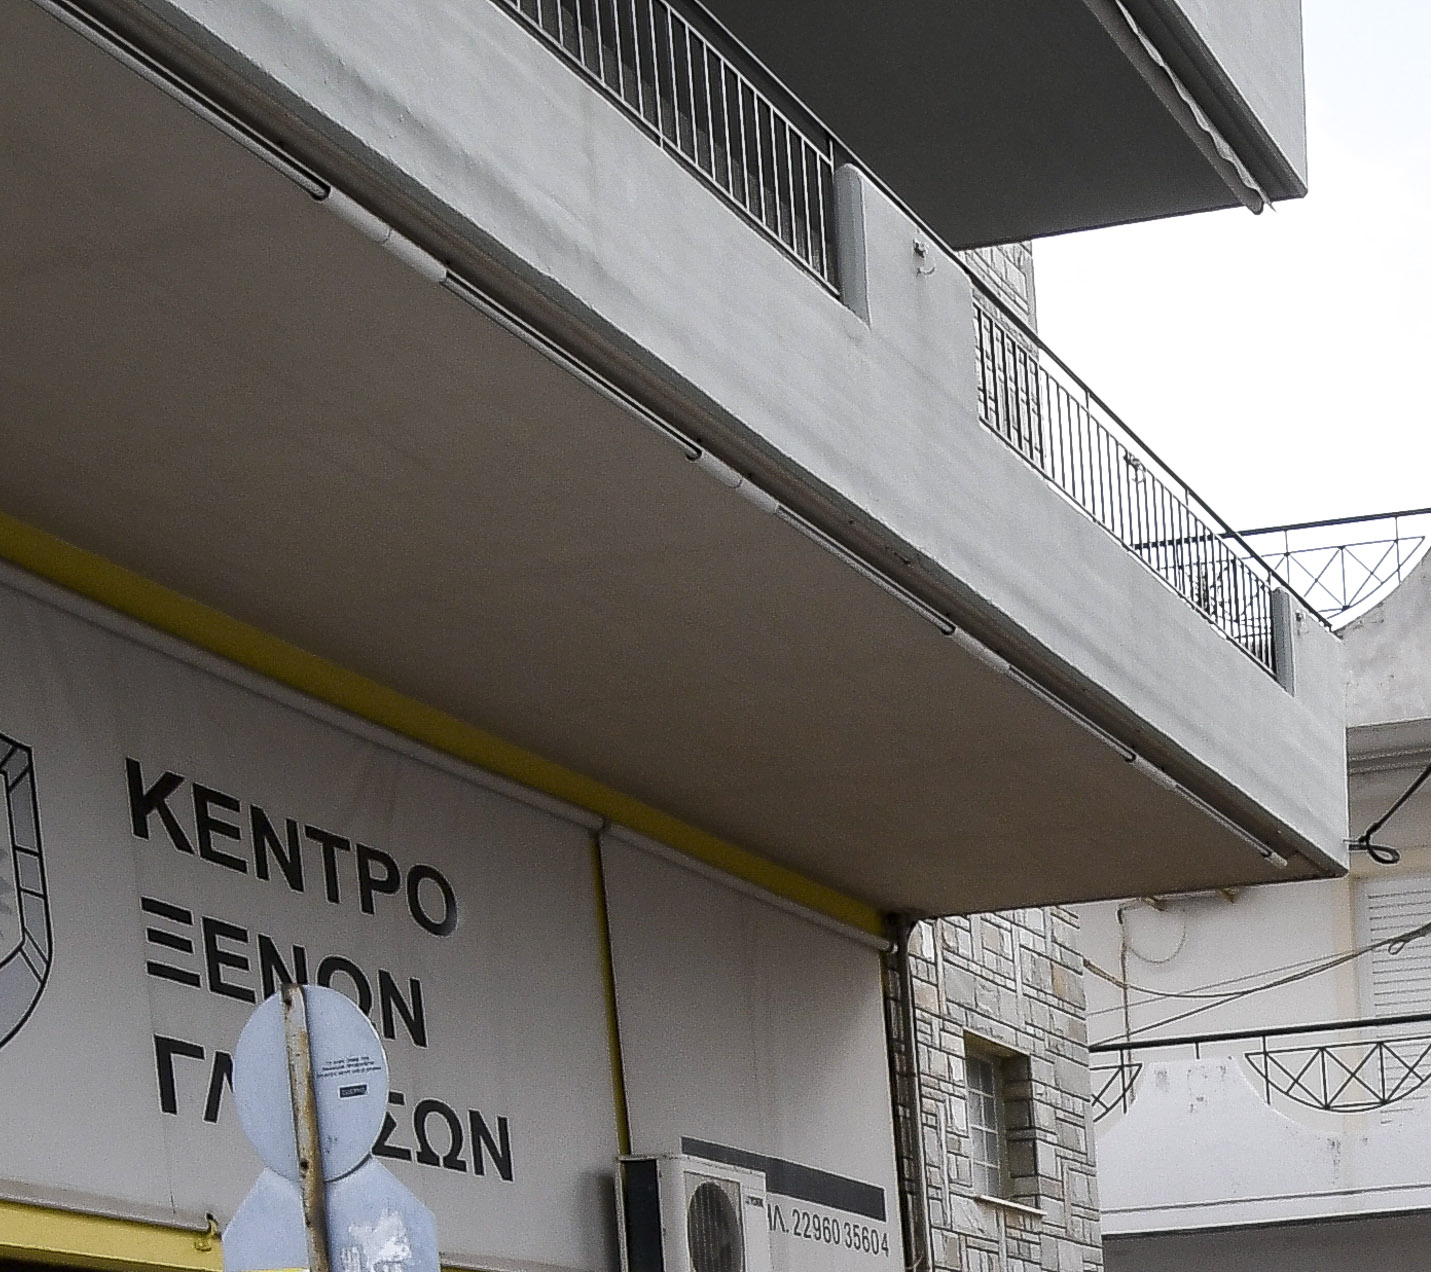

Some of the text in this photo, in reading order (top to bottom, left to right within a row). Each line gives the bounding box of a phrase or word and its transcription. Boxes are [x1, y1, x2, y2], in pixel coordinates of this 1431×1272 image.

[125, 756, 459, 937] ΚΕΝΤΡΟ
[791, 1208, 841, 1245] 22960
[843, 1221, 889, 1258] 35604
